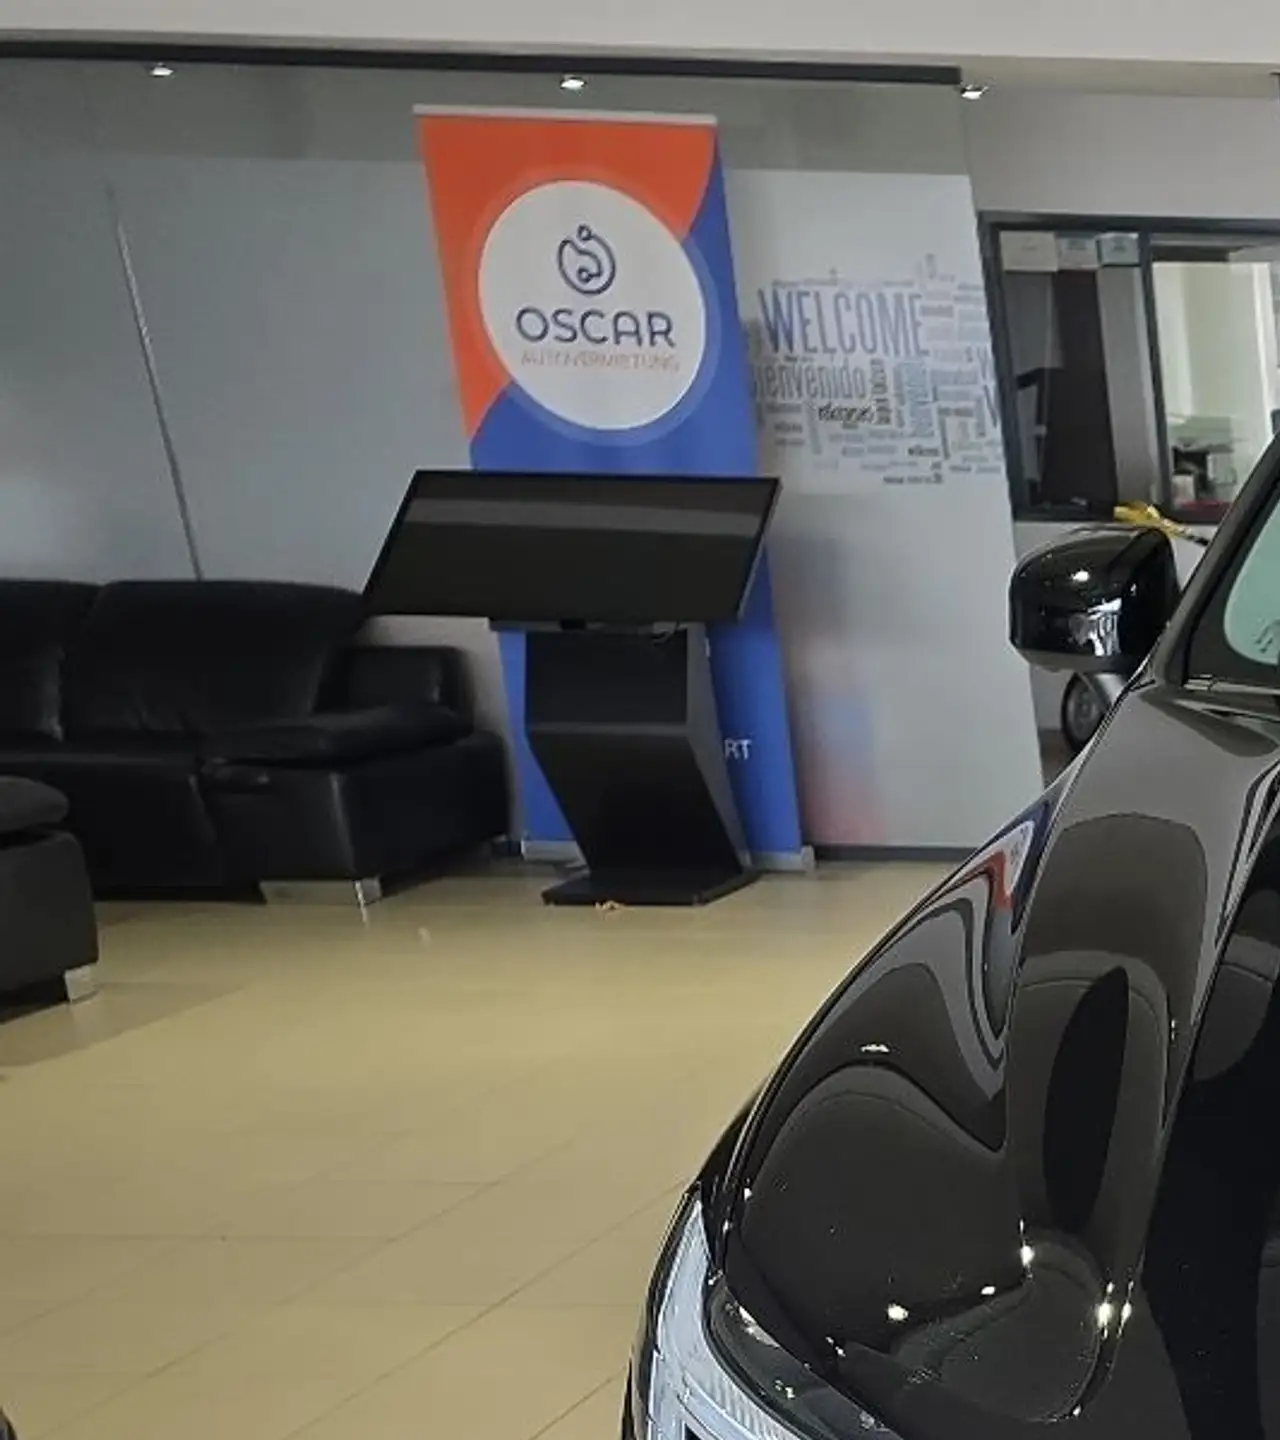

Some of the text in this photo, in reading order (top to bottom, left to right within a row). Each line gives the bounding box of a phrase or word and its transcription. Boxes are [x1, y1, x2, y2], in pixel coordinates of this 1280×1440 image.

[515, 306, 677, 348] OSCAR
[757, 287, 930, 357] WELCOME
[724, 738, 753, 760] RT
